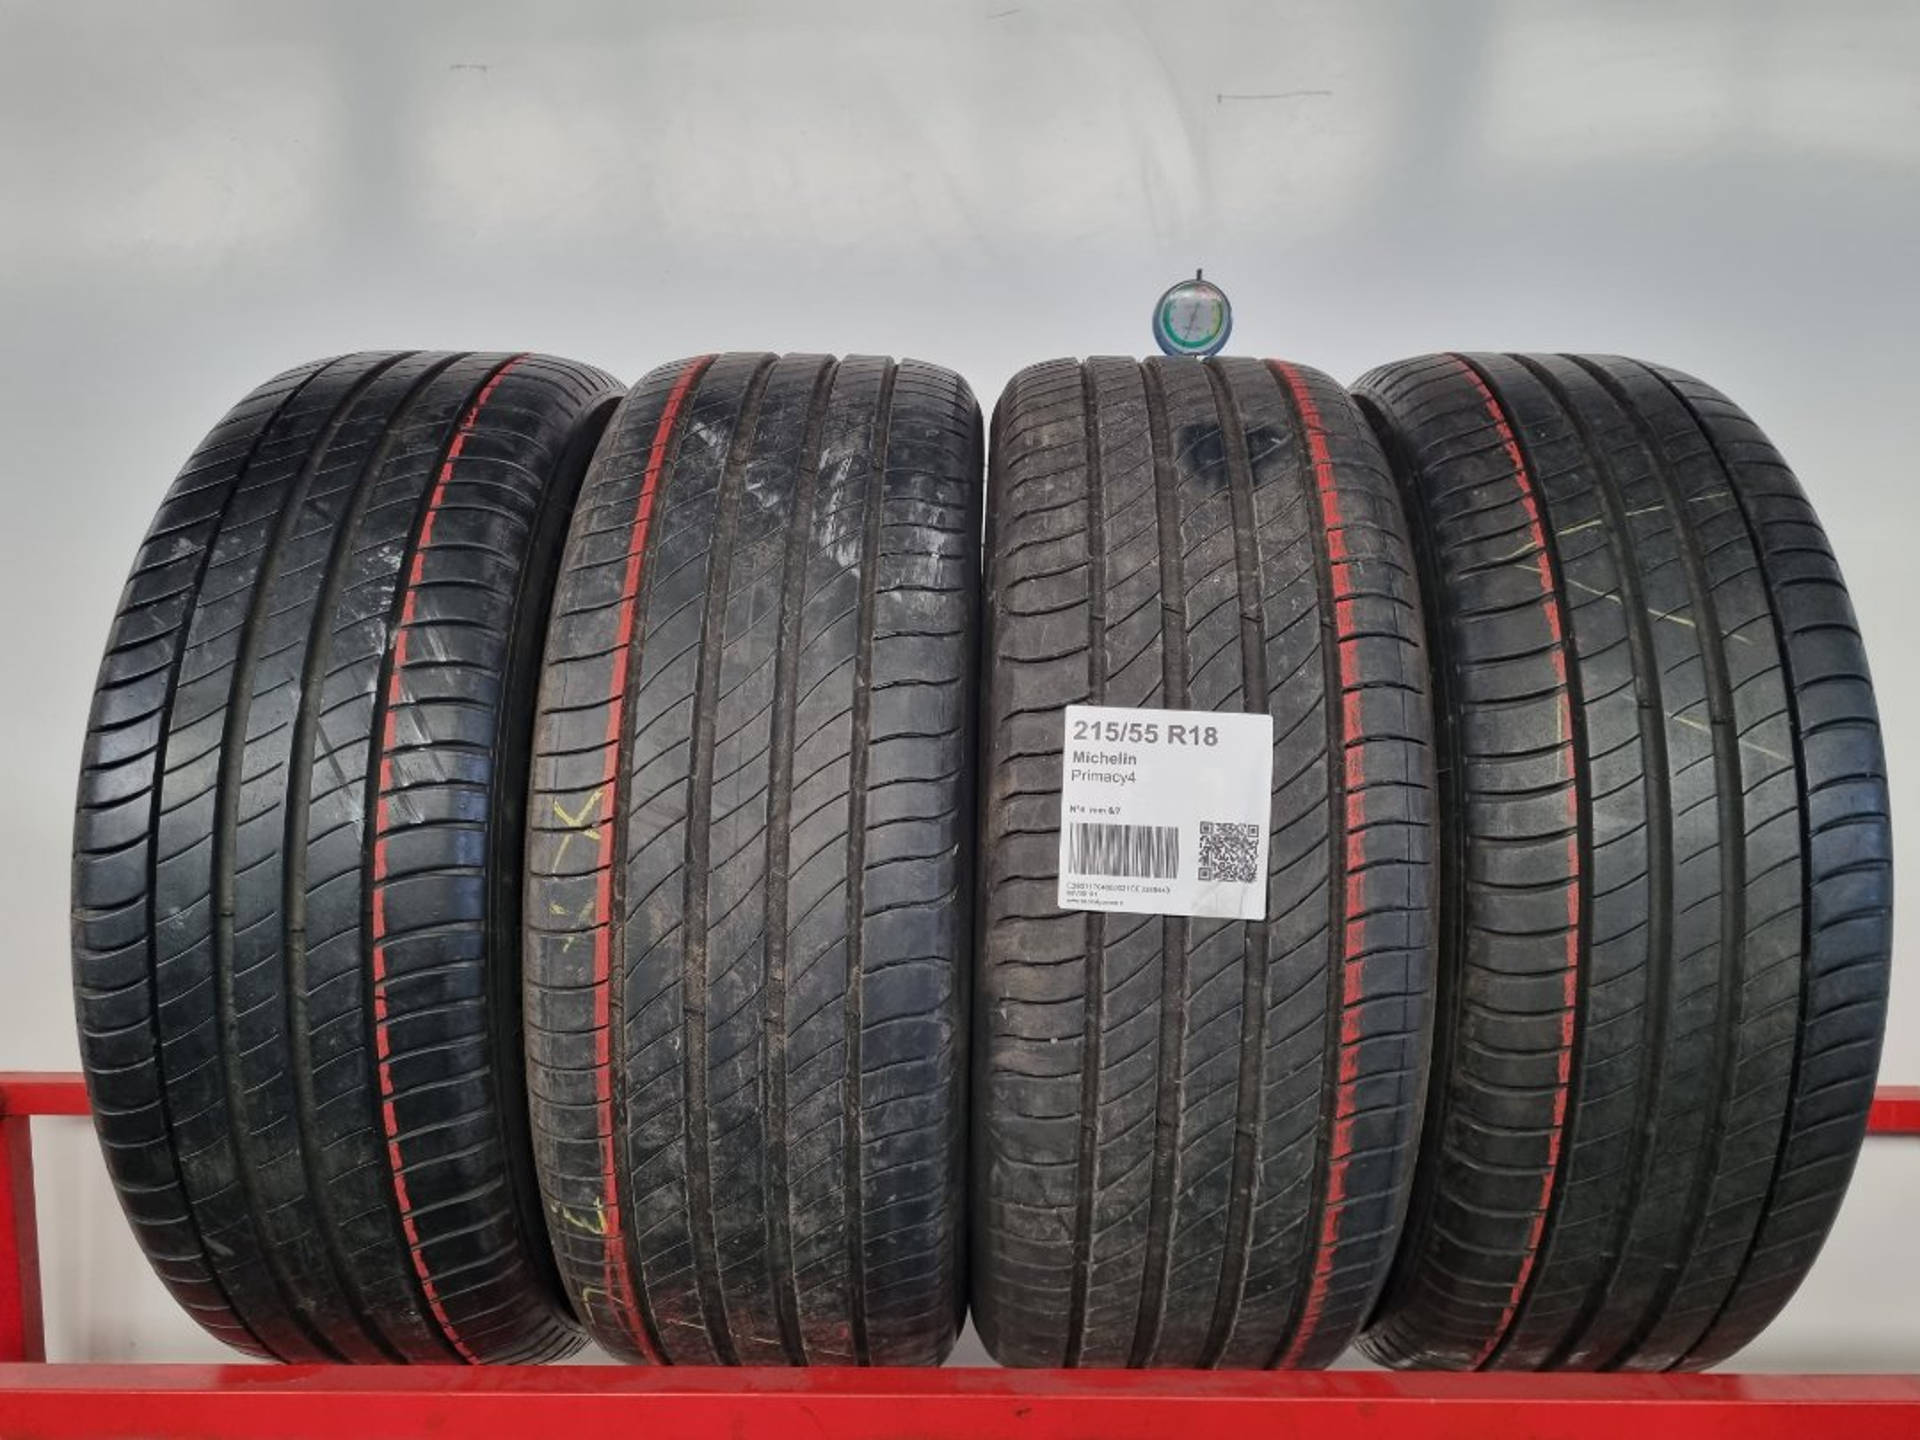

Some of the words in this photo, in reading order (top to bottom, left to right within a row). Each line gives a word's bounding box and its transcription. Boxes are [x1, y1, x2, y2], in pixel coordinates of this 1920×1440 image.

[1073, 720, 1158, 743] 215/55
[1167, 724, 1219, 746] R18
[1072, 750, 1137, 765] Michelin
[1071, 769, 1137, 786] Primacy4
